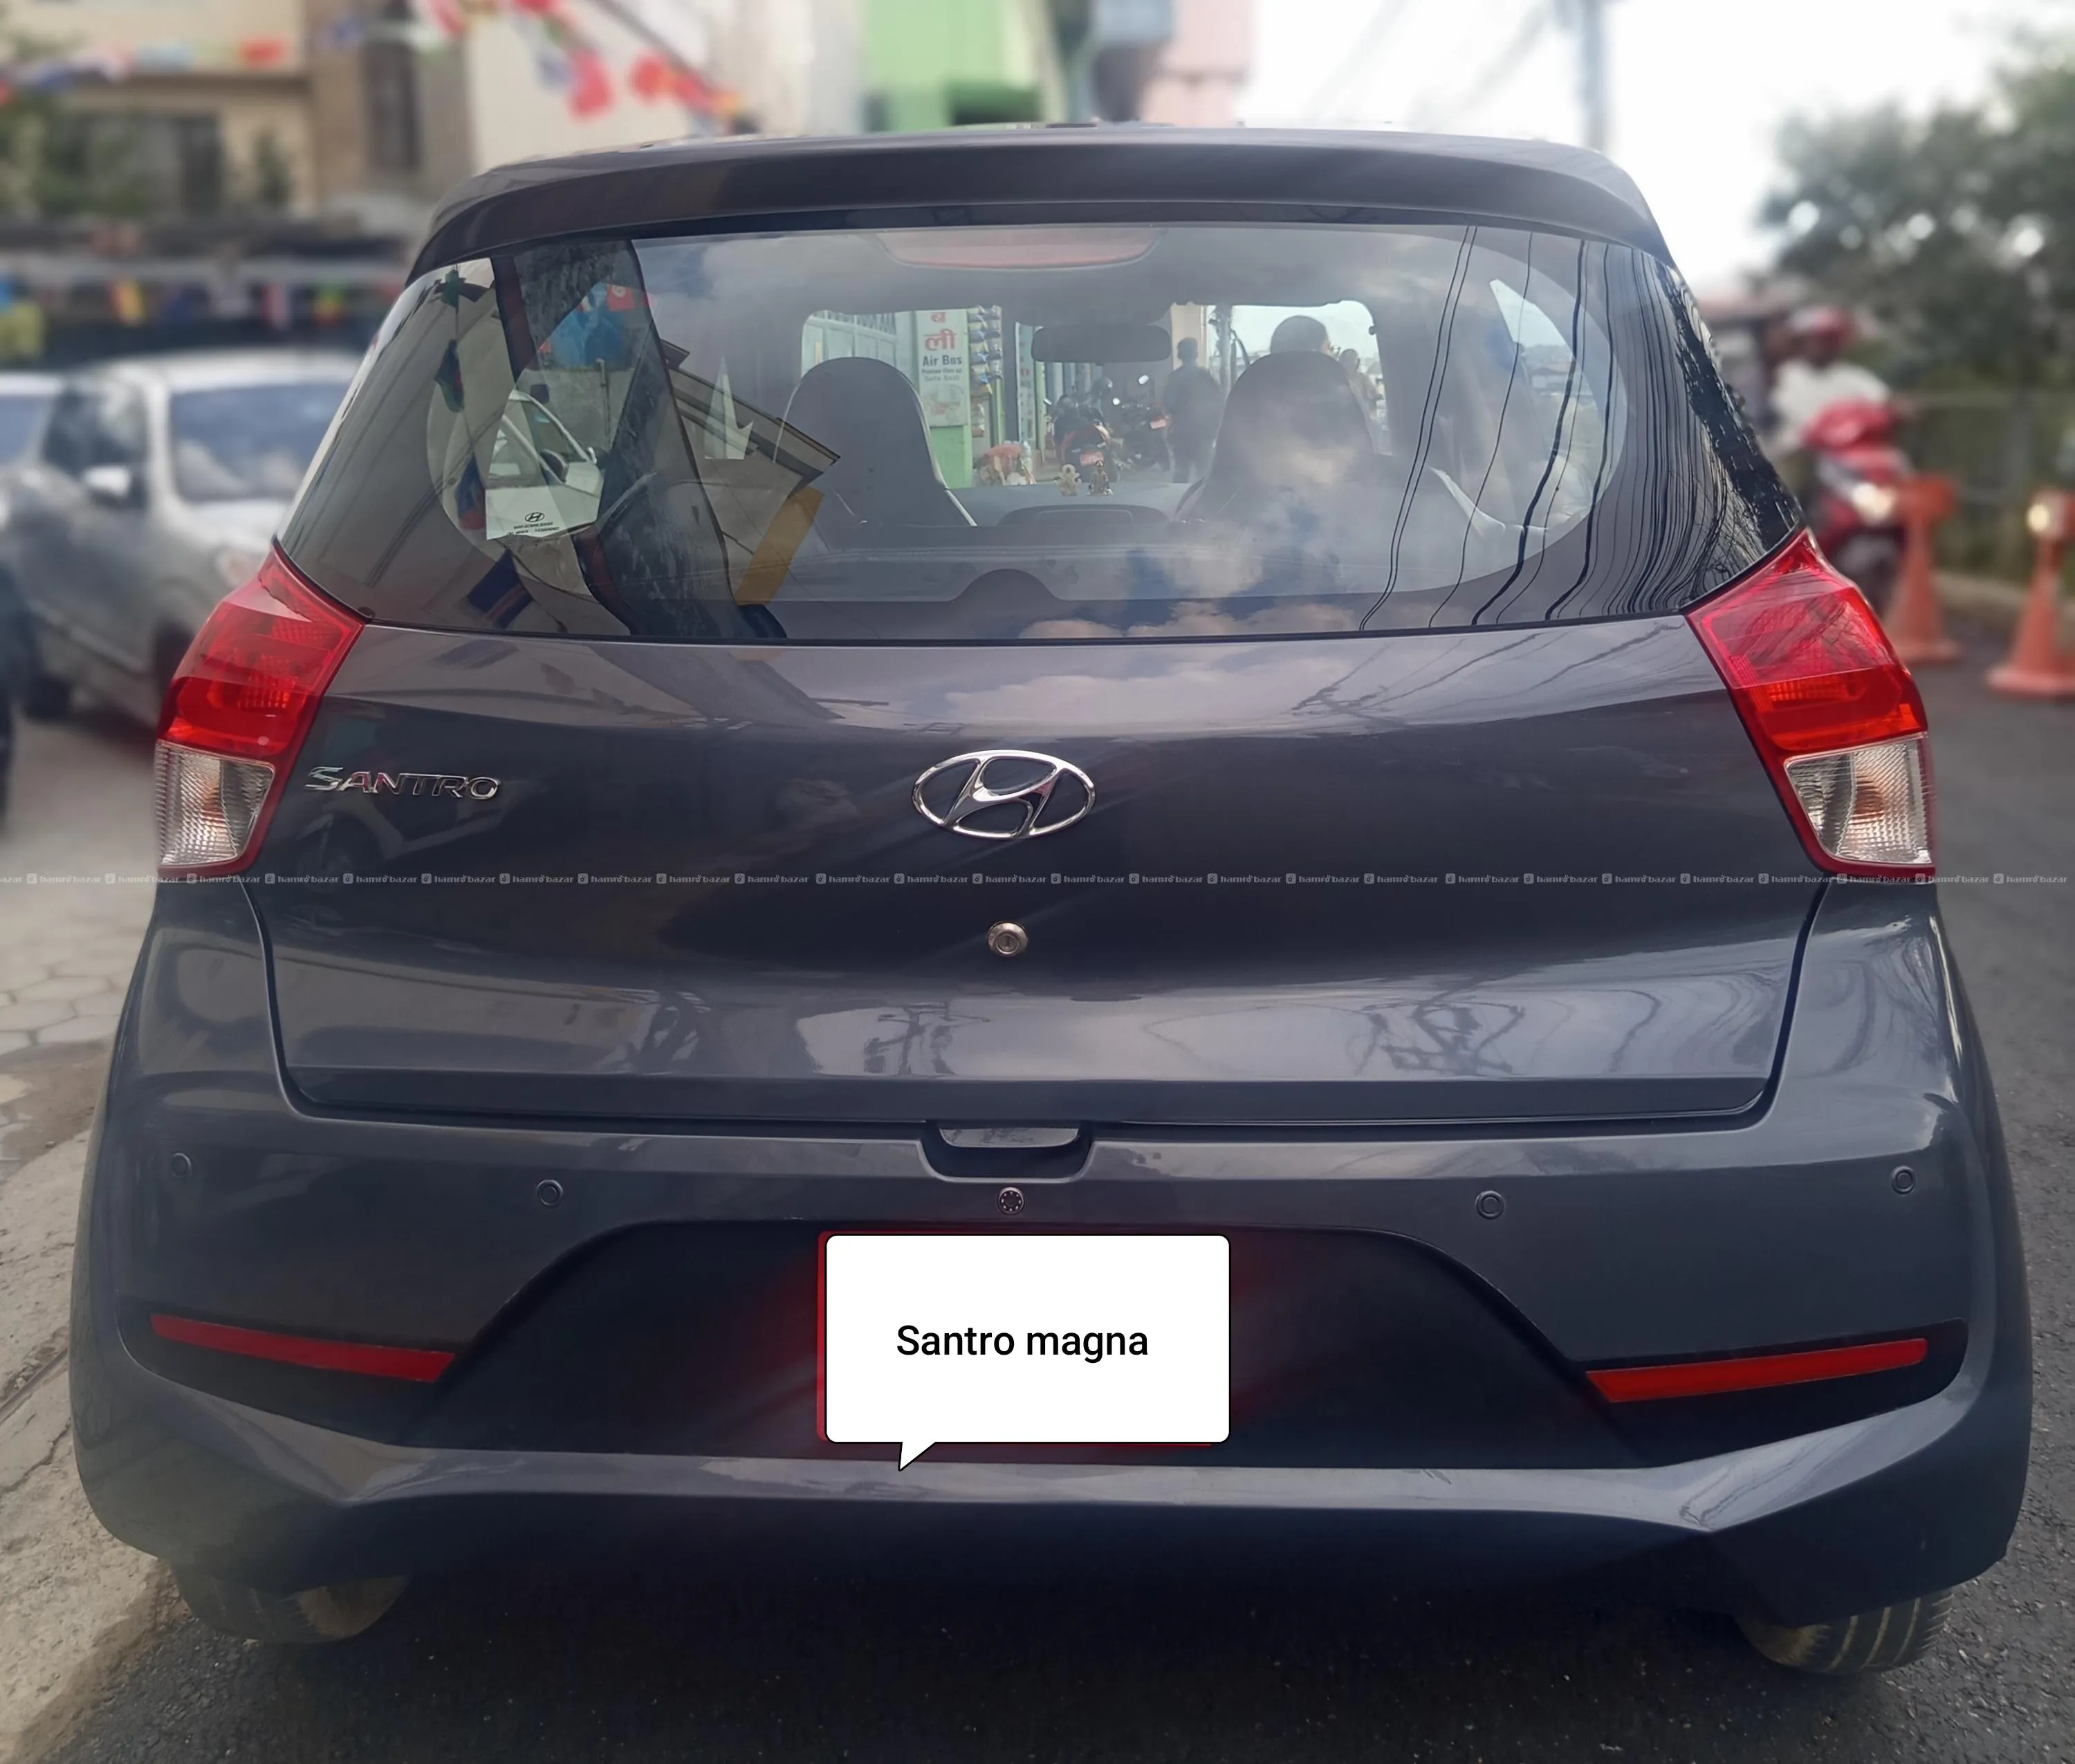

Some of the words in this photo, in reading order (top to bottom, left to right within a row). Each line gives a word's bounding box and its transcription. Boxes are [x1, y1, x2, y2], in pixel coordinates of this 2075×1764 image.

[923, 355, 939, 366] Air
[942, 355, 963, 365] Bus
[305, 766, 500, 799] SANTRO
